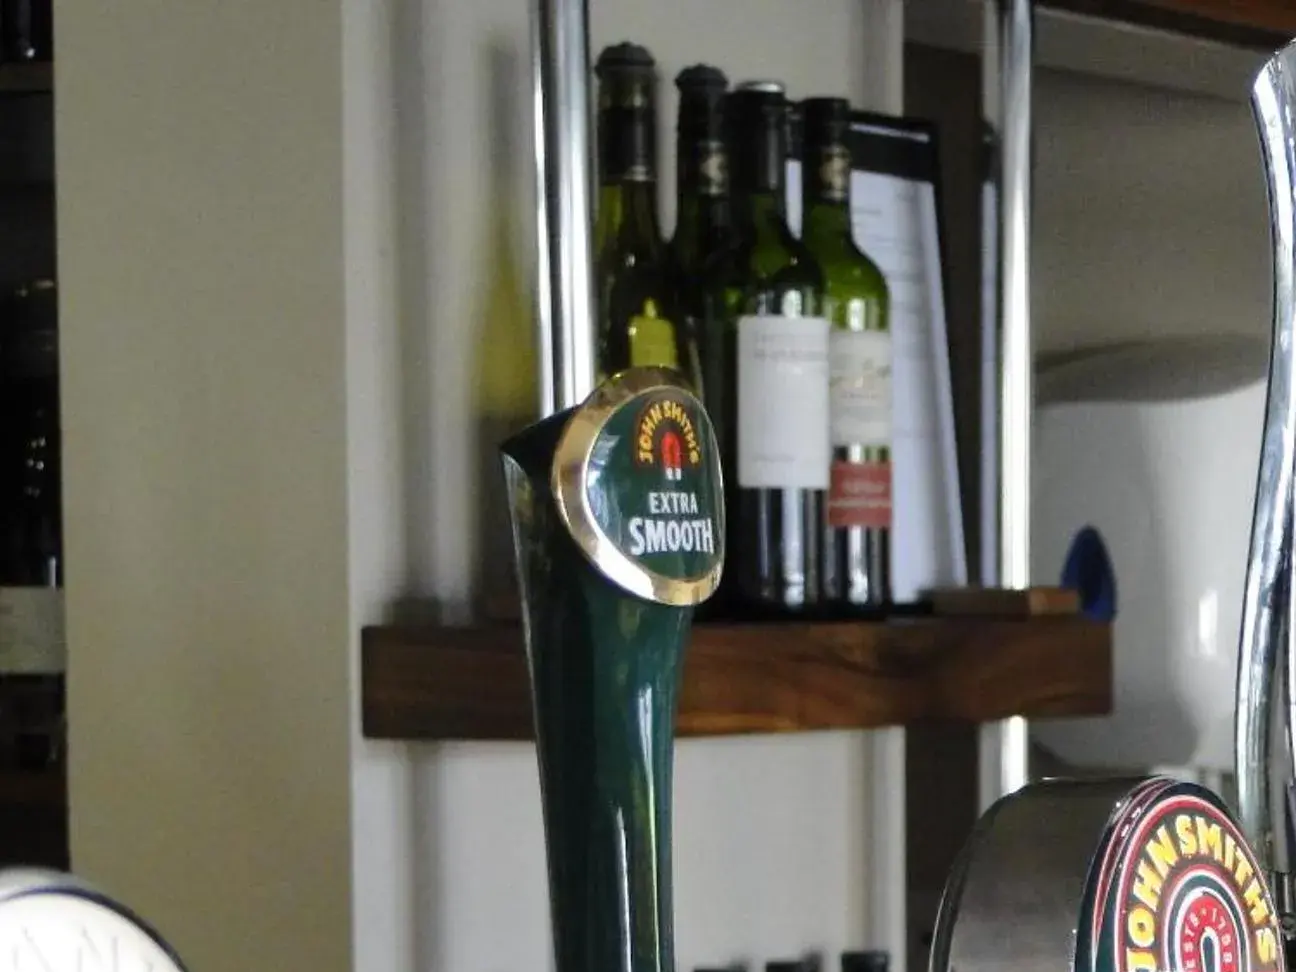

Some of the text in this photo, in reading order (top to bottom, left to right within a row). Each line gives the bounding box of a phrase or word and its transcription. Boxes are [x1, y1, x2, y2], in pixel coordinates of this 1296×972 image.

[638, 403, 661, 465] JOHN
[649, 492, 698, 515] EXTRA
[628, 518, 714, 556] SMOOTH
[1175, 813, 1277, 965] SMITH'S
